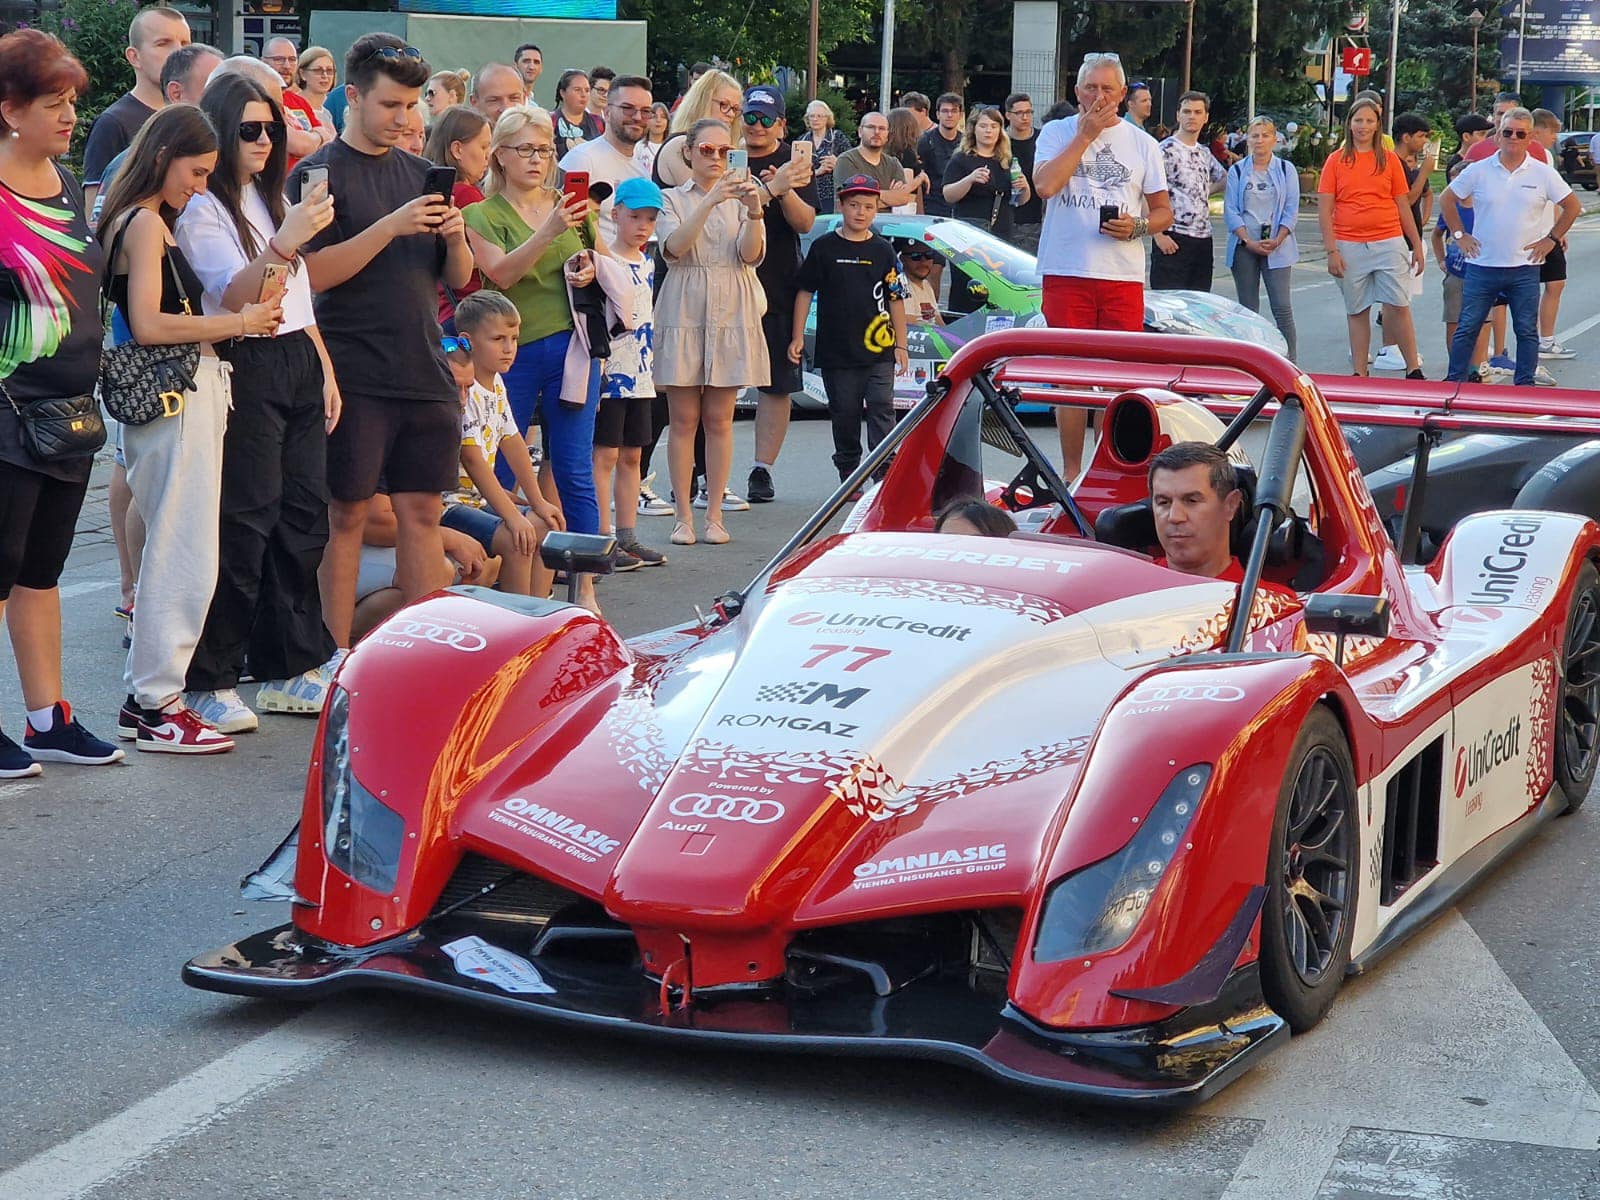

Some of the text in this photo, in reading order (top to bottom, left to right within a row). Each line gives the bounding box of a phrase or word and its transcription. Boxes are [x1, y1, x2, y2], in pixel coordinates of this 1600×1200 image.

[834, 544, 1083, 574] SUPERBET
[826, 613, 972, 642] UniCredit
[375, 637, 414, 649] Audi
[800, 644, 892, 673] 77
[1122, 704, 1170, 717] Audi
[717, 714, 860, 738] ROMGAZ
[1468, 713, 1521, 787] UniCredit
[708, 782, 775, 796] Powered by
[504, 798, 621, 854] OMNIASIG
[658, 821, 708, 833] Audi
[853, 844, 1007, 877] OMNIASIG
[853, 863, 1007, 890] VIENNA INSURANCE GROUP
